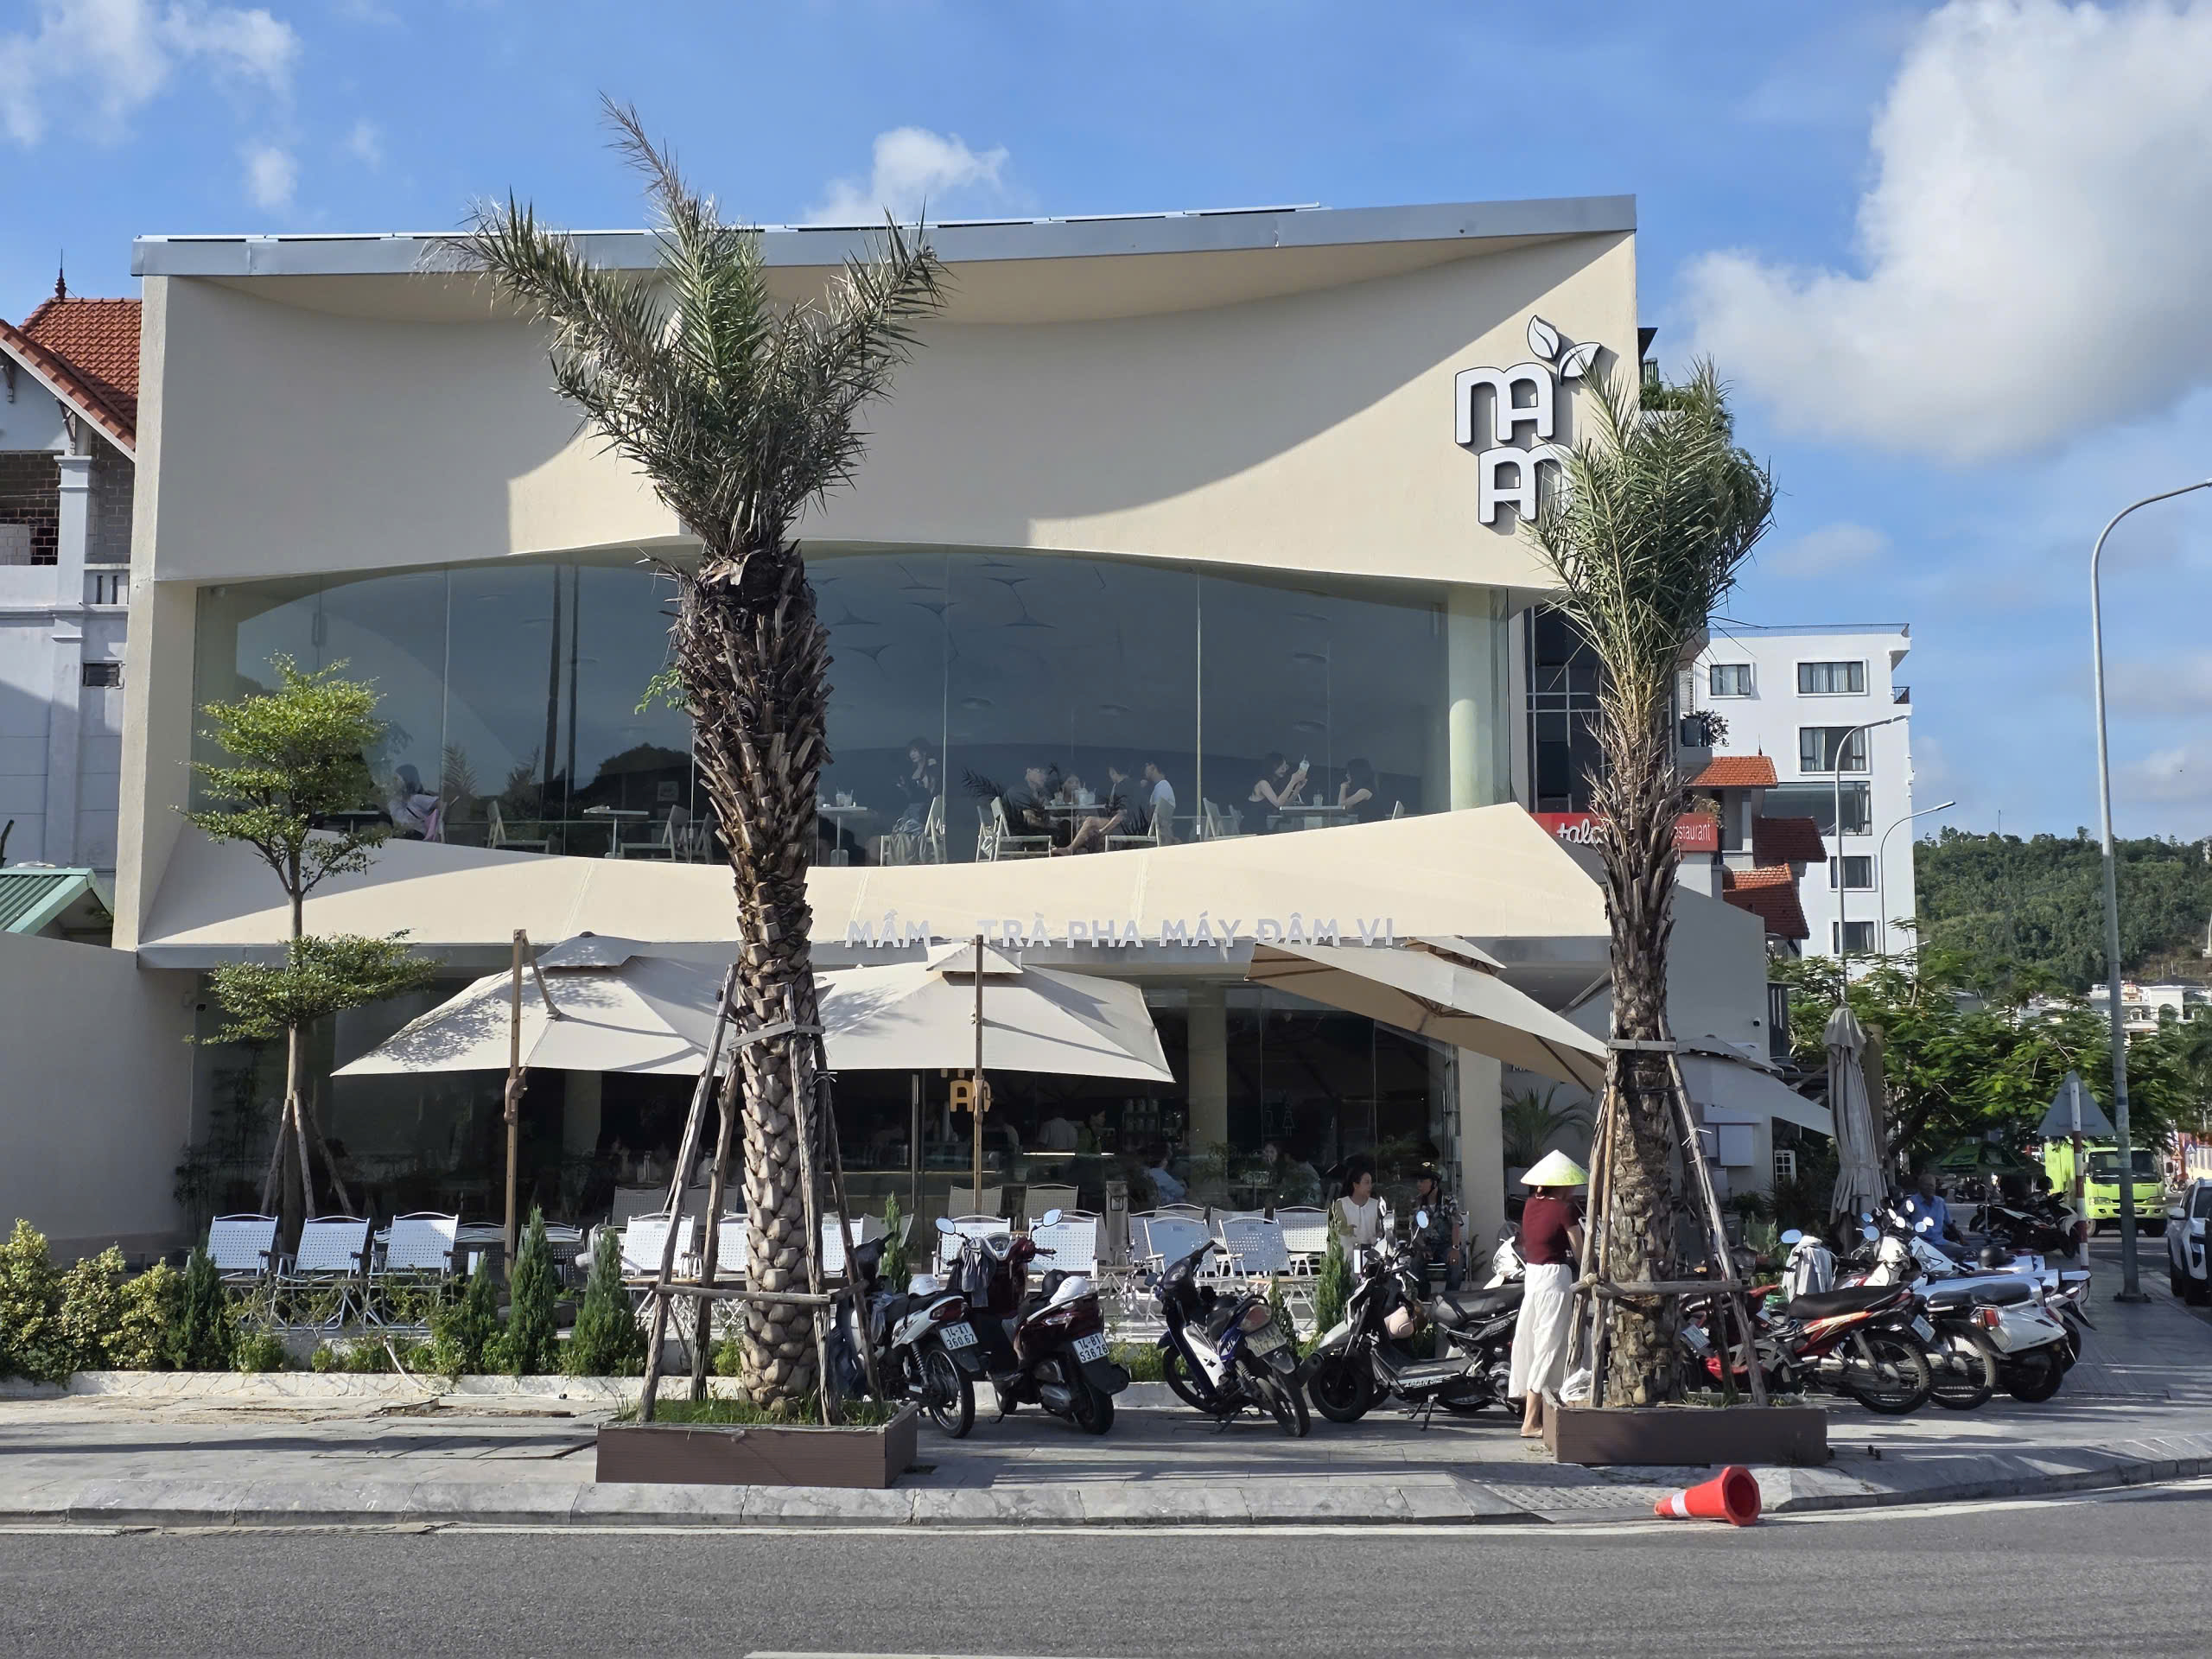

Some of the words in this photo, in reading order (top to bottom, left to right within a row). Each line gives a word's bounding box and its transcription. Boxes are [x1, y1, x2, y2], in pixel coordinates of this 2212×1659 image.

[976, 912, 1052, 948] TRÀ
[1066, 919, 1144, 949] PHA
[1159, 910, 1243, 948] MÁY
